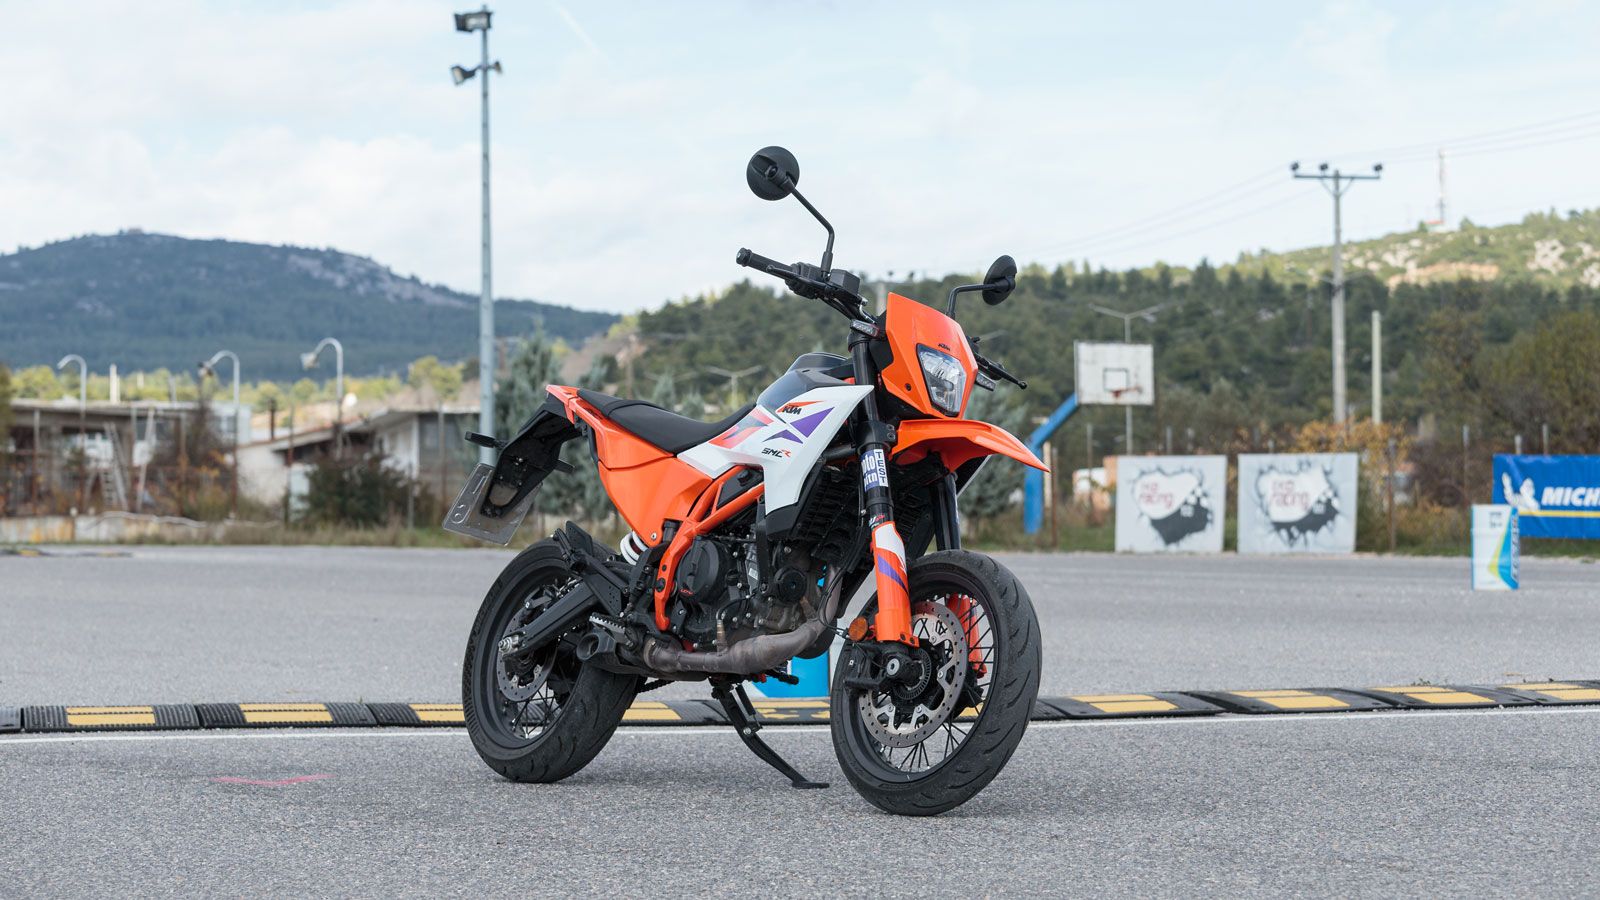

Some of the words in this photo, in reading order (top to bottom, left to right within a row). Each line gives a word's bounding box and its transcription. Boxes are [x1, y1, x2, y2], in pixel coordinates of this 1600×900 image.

[782, 405, 802, 415] KTM
[875, 451, 886, 484] TEST
[1541, 486, 1600, 507] MICH
